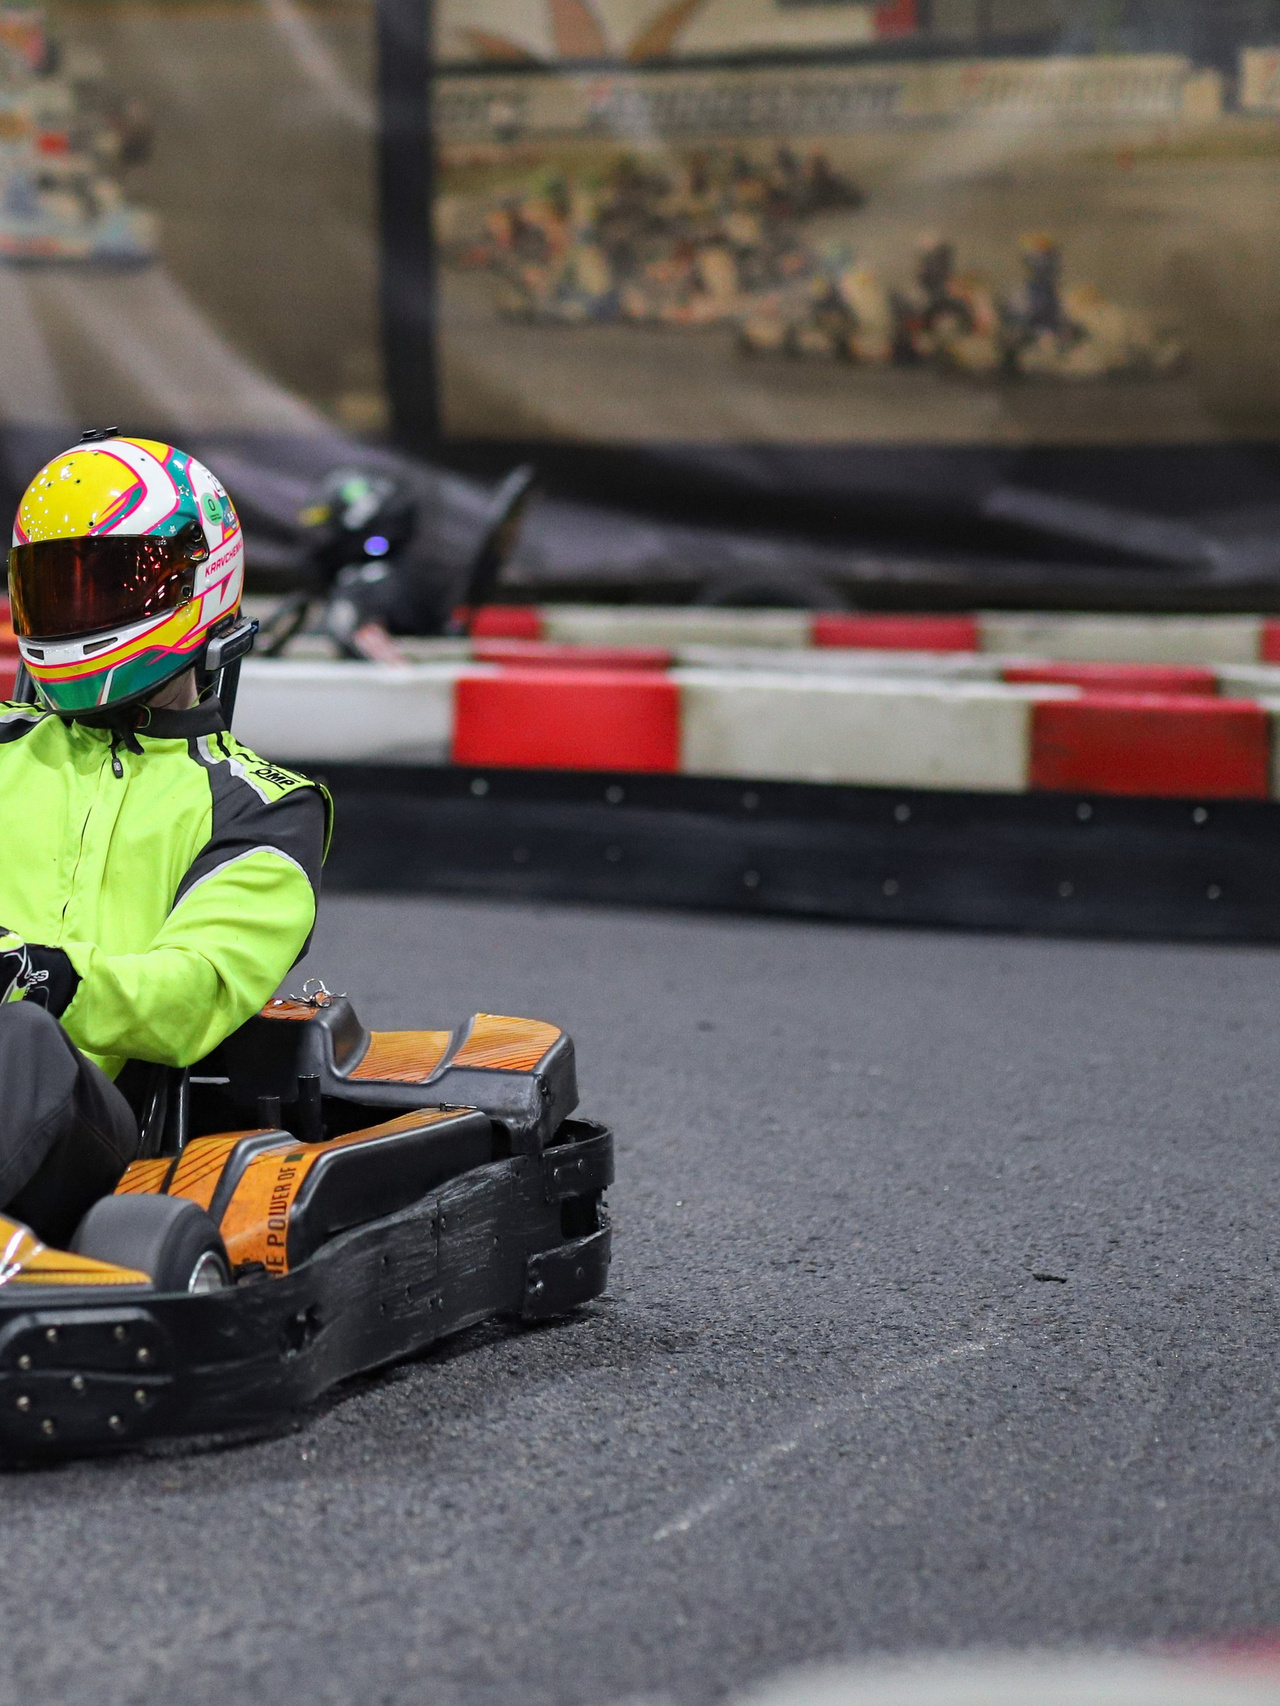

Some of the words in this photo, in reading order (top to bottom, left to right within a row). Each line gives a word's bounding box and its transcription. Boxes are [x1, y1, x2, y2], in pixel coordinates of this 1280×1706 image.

[254, 767, 296, 787] OMP
[278, 1167, 297, 1183] OF
[267, 1183, 292, 1248] POWER
